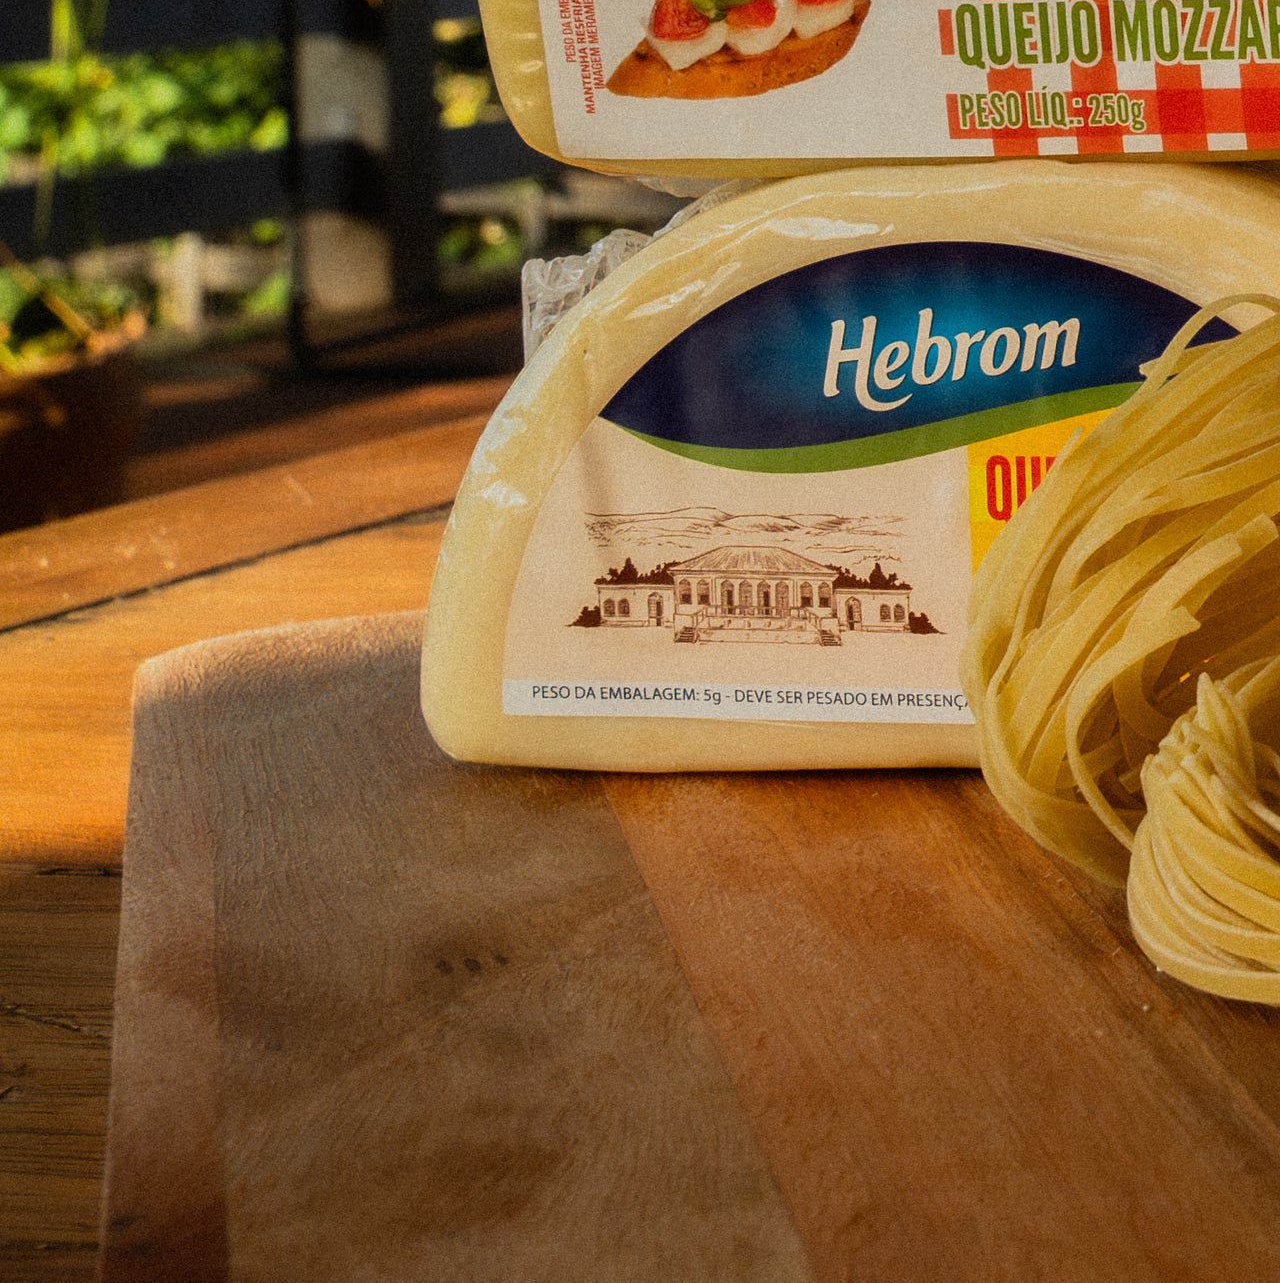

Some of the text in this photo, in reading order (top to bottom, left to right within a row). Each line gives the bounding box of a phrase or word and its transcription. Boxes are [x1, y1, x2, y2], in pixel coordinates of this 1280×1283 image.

[562, 21, 573, 35] DA
[564, 37, 576, 63] PESO
[957, 1, 1100, 67] QUEIJO
[578, 47, 596, 114] MANTENHA
[590, 47, 605, 90] IMAGEM
[960, 86, 1144, 130] PESO LÍQ.: 250g
[823, 308, 1081, 412] Hebrom
[986, 455, 1058, 523] QU
[532, 686, 570, 699] PESO
[574, 686, 596, 700] DA
[600, 686, 700, 701] EMBALAGEM:
[703, 689, 722, 706] 5g
[734, 689, 772, 704] DEVE
[777, 690, 802, 704] SER
[807, 691, 867, 706] PESADO
[872, 692, 892, 706] EM
